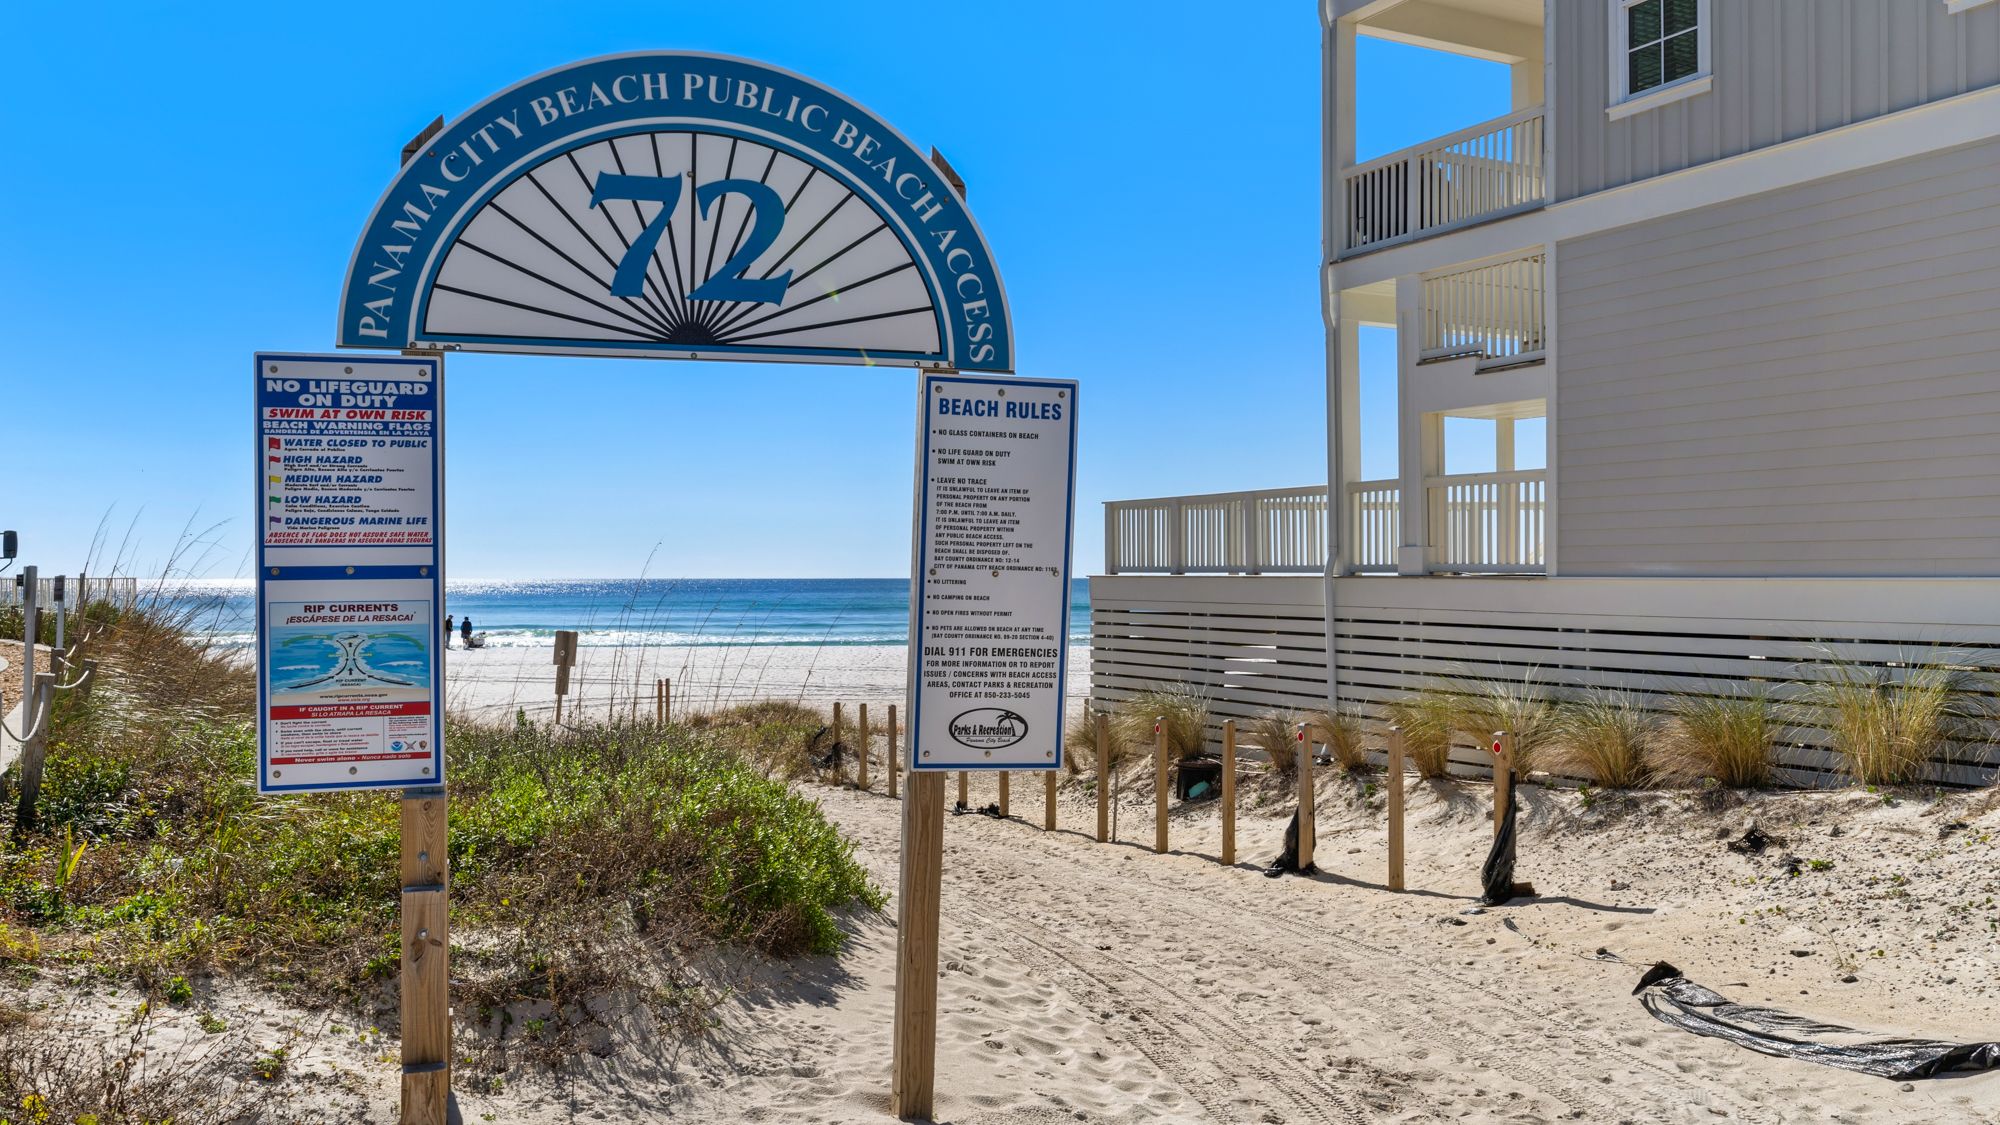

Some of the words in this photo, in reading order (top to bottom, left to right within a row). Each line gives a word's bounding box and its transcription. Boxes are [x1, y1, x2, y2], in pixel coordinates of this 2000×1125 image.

[358, 184, 452, 341] PANAMA
[439, 111, 526, 183] CITY
[530, 71, 670, 128] BEACH
[682, 72, 830, 133] PUBLIC
[831, 119, 944, 224] BEACH
[930, 227, 996, 365] ACCESS
[588, 171, 796, 307] 72
[266, 380, 300, 392] NO
[309, 381, 428, 395] LIFEGUARD
[298, 394, 332, 406] ON
[341, 395, 398, 407] DUTY
[939, 398, 998, 417] BEACH
[1006, 401, 1062, 420] RULES
[269, 409, 314, 418] SWIM
[320, 410, 340, 419] AT
[346, 410, 385, 419] OWN
[391, 410, 426, 420] RISK
[263, 421, 308, 429] BEACH
[313, 421, 383, 430] WARNING
[389, 422, 431, 431] FLAGS
[970, 430, 1006, 438] CONTAINERS
[284, 439, 322, 447] WATER
[327, 439, 367, 447] CLOSED
[390, 440, 427, 448] PUBLIC
[283, 456, 312, 464] HIGH
[316, 456, 362, 464] HAZARD
[285, 475, 332, 483] MEDIUM
[336, 475, 382, 483] HAZARD
[285, 496, 311, 504] LOW
[315, 496, 362, 504] HAZARD
[285, 517, 354, 525] DANGEROUS
[359, 517, 402, 525] MARINE
[330, 604, 398, 612] CURRENTS
[286, 615, 341, 624] ¡ESCÁPESE
[343, 615, 356, 623] DE
[372, 614, 414, 622] RESACA!
[925, 647, 945, 656] DIAL
[950, 647, 965, 656] 911
[970, 648, 988, 656] FOR
[992, 648, 1058, 658] EMERGENCIES
[954, 725, 971, 735] Parks
[973, 725, 977, 735] &
[979, 725, 1012, 735] Recreation
